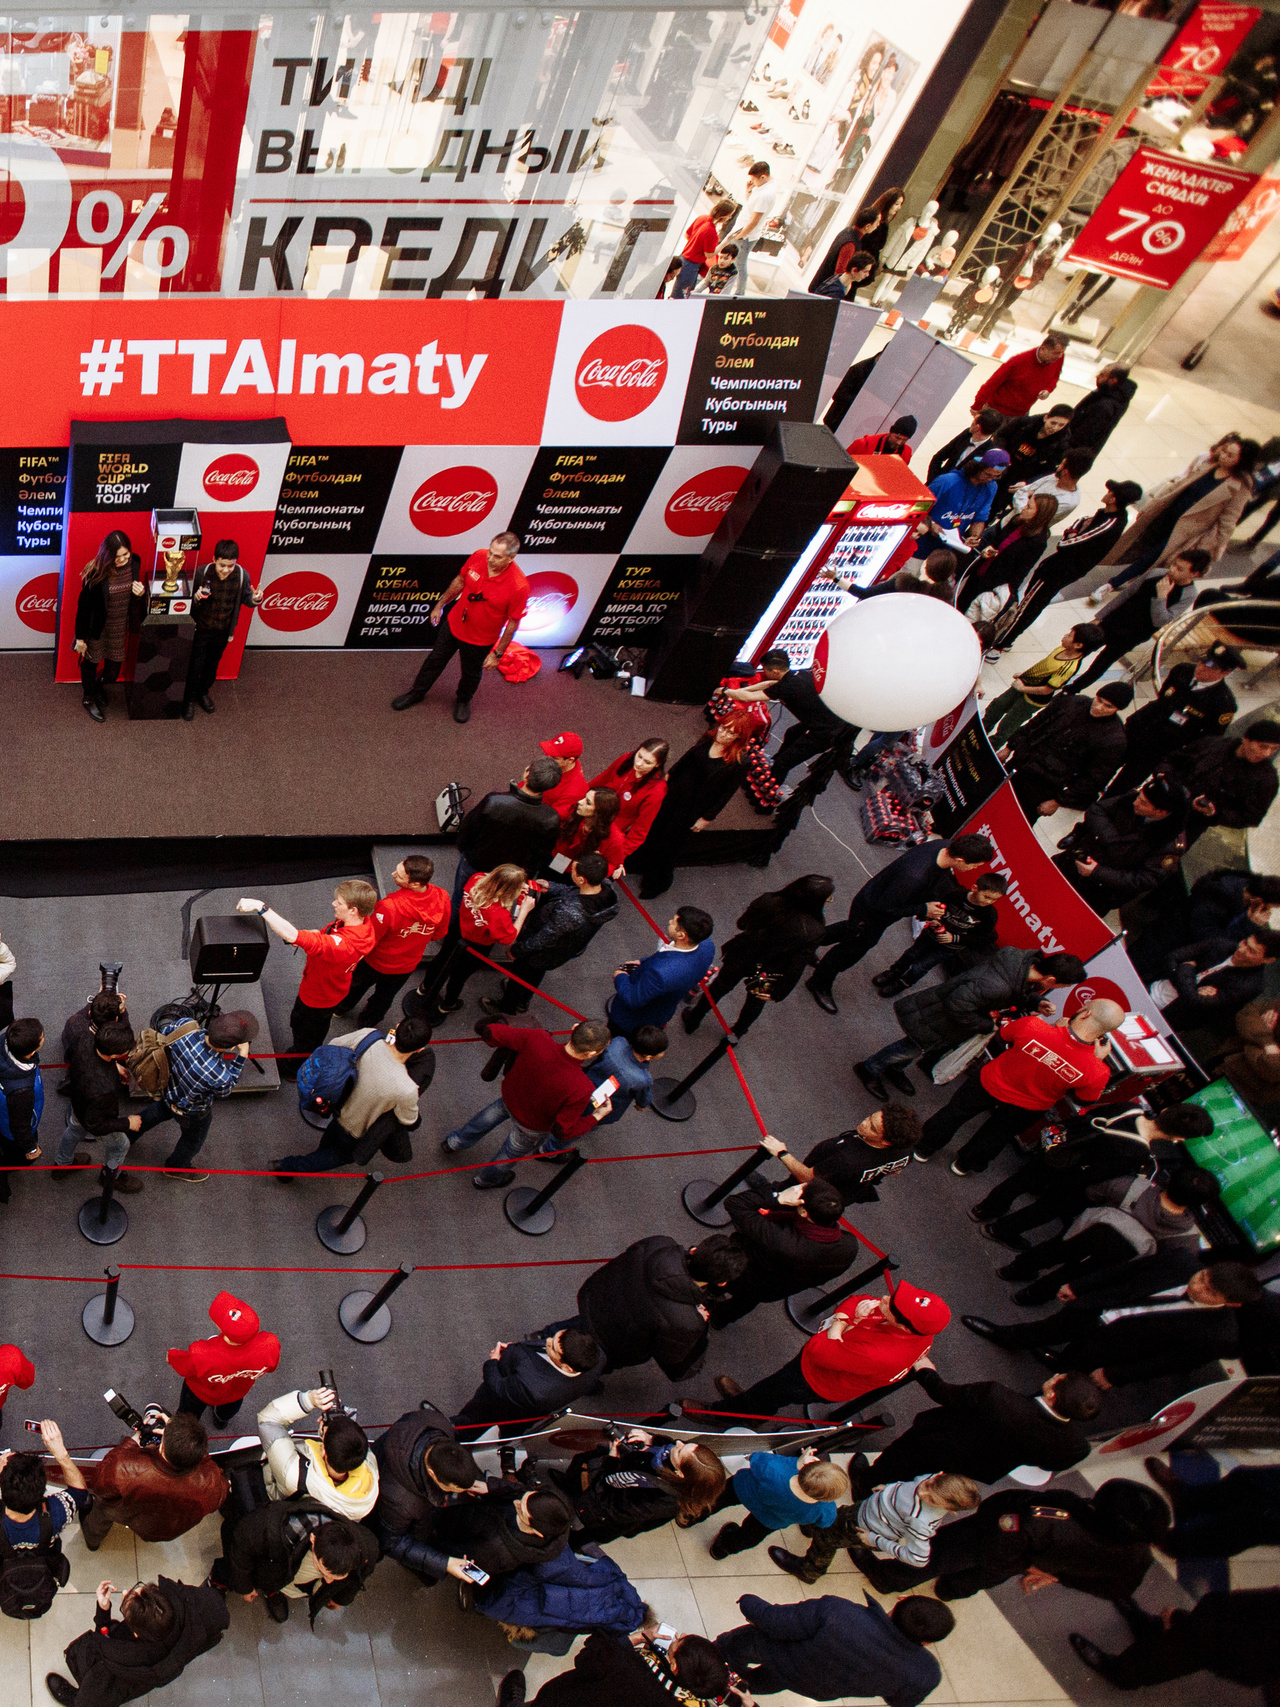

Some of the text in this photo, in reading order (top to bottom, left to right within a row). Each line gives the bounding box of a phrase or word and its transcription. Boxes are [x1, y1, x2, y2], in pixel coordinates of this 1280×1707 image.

[1146, 181, 1209, 206] СКИДКИ
[1152, 204, 1173, 215] ДО
[239, 216, 671, 300] КРЕДИТ
[720, 333, 800, 350] Футболдан
[715, 355, 755, 368] Әлем
[80, 338, 489, 410] #TTAlmaty
[578, 358, 666, 389] Coca-Cola
[710, 376, 802, 390] Чемпионаты
[701, 418, 737, 434] Туры
[99, 453, 130, 464] FIFA
[98, 463, 149, 474] WORLD
[204, 469, 260, 487] Coca-Cola
[285, 471, 362, 485] Футболдан
[549, 471, 626, 485] Футболдан
[95, 483, 151, 494] TROPHY
[281, 488, 319, 499] Әлем
[542, 488, 580, 499] Әлем
[18, 490, 56, 500] Әлем
[95, 493, 132, 504] TOUR
[413, 491, 497, 513] Coca-Cola
[669, 491, 732, 512] Coca-Co
[18, 505, 63, 516] Чемпи
[278, 504, 365, 514] Чемпионаты
[536, 503, 623, 514] Чемпионаты
[16, 536, 51, 548] Туры
[271, 534, 304, 546] Туры
[523, 534, 557, 546] Туры
[380, 567, 406, 577] ТУР
[625, 567, 652, 576] ТУР
[375, 579, 419, 589] КУБКА
[617, 580, 661, 589] КУБКА
[613, 591, 680, 601] ЧЕМПИОН
[367, 604, 430, 613] МИРА ПО
[604, 603, 668, 613] МИРА ПО
[364, 616, 429, 625] ФУТБОЛУ
[599, 615, 664, 625] ФУТБОЛУ
